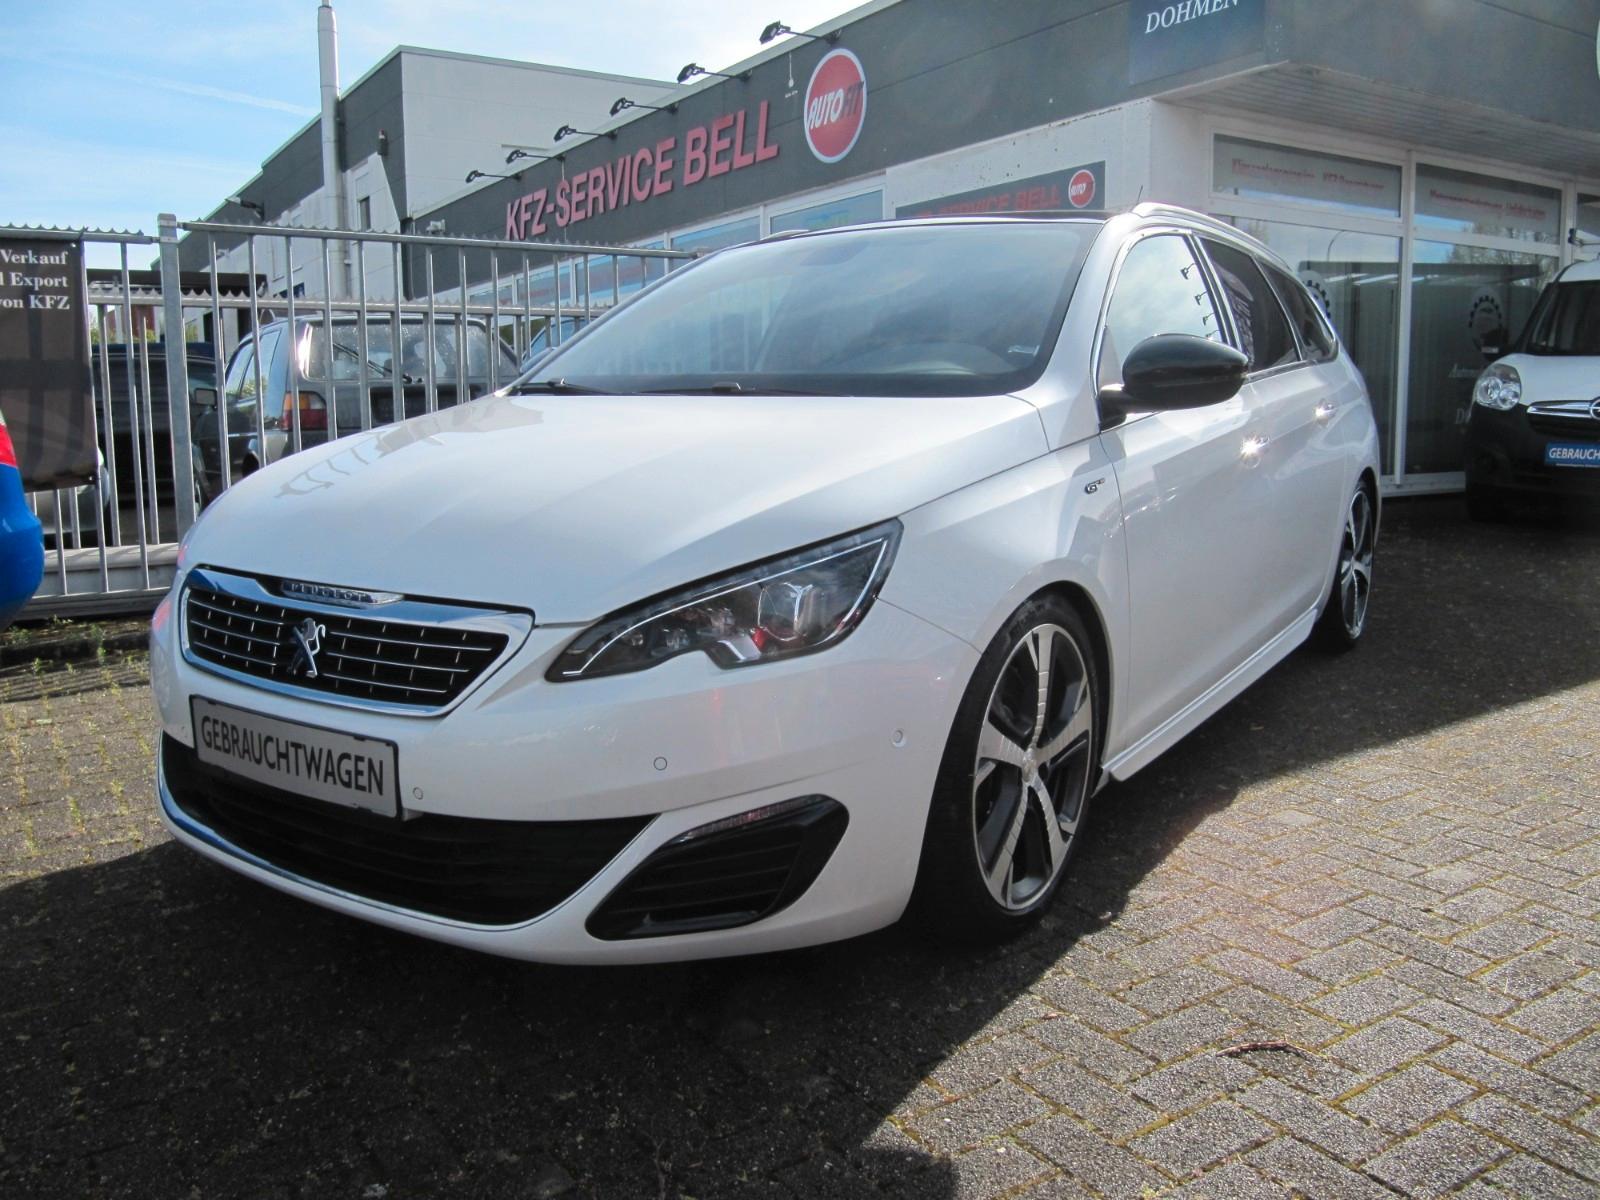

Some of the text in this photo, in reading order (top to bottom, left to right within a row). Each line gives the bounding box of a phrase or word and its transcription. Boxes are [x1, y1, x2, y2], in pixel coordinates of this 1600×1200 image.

[505, 101, 780, 240] KFZ-SERVICE BELL
[0, 249, 69, 265] Verkauf
[9, 271, 68, 291] Export
[0, 294, 70, 310] on KFZ
[200, 715, 385, 796] GEBRAUCHTWAGEN
